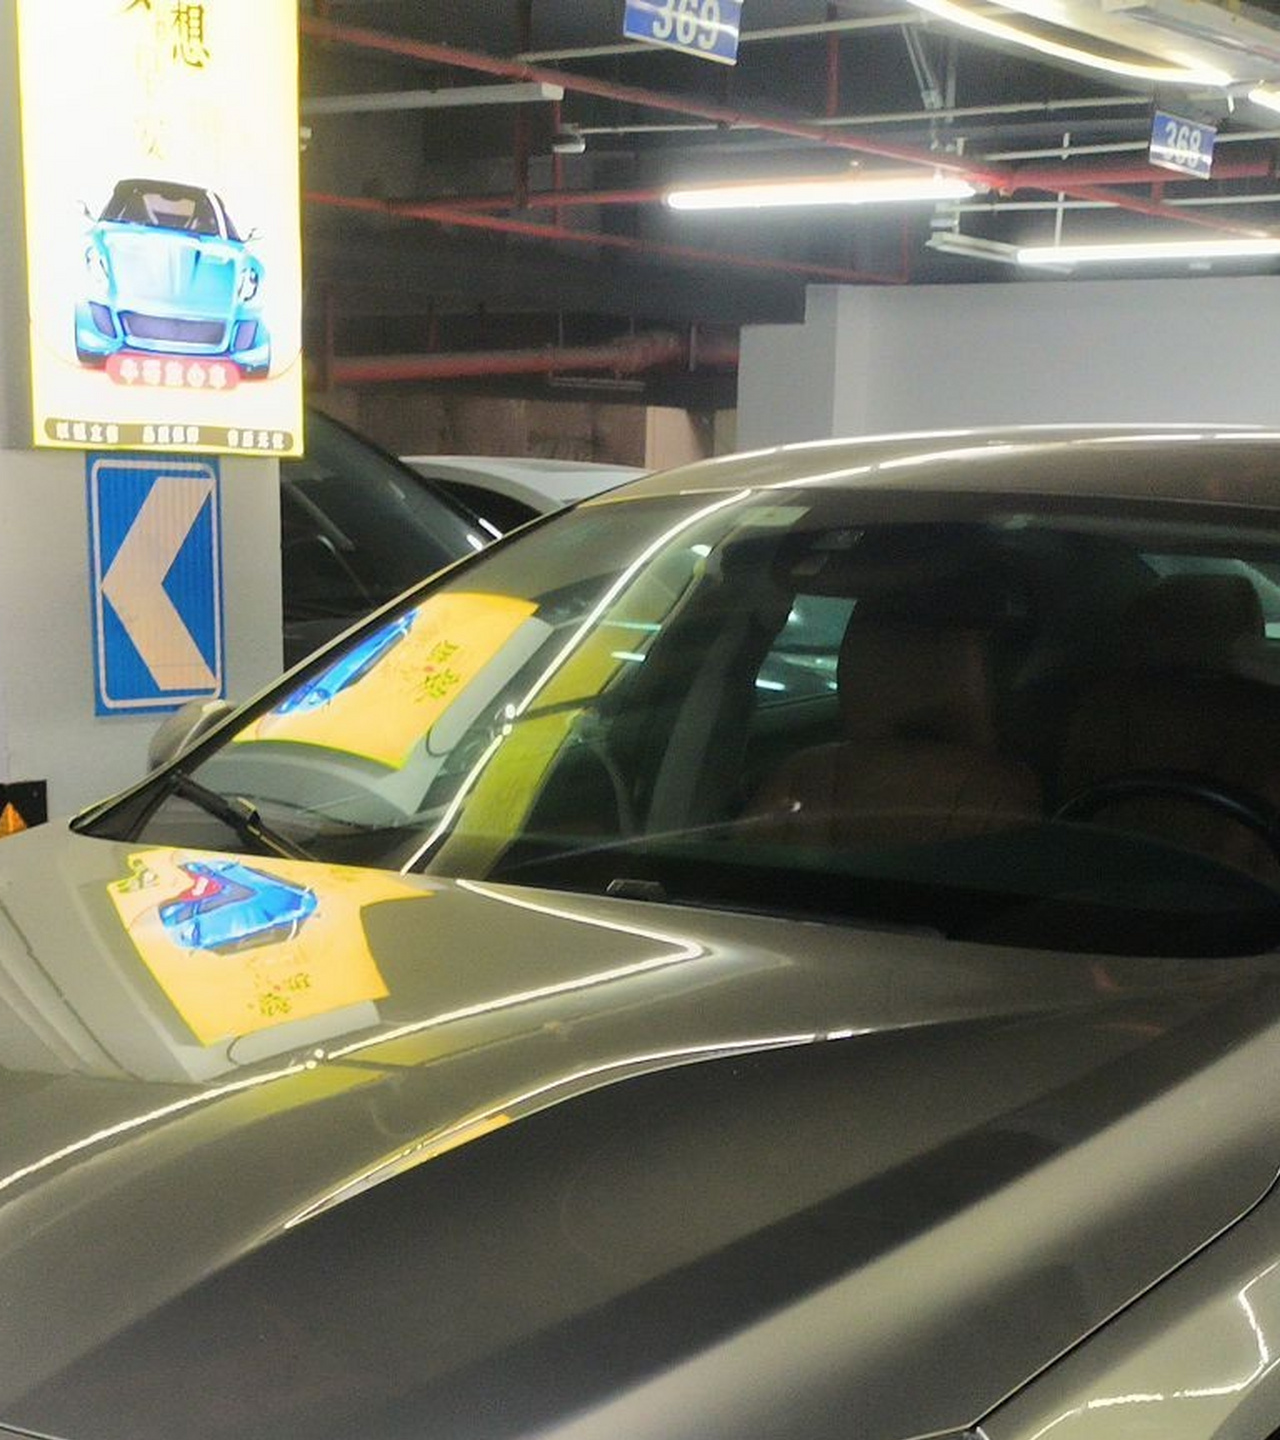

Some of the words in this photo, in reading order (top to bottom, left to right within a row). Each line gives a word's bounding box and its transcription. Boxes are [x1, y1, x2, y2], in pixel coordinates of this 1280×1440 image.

[171, 0, 210, 68] 想
[652, 0, 721, 50] 369
[1164, 121, 1202, 169] 368
